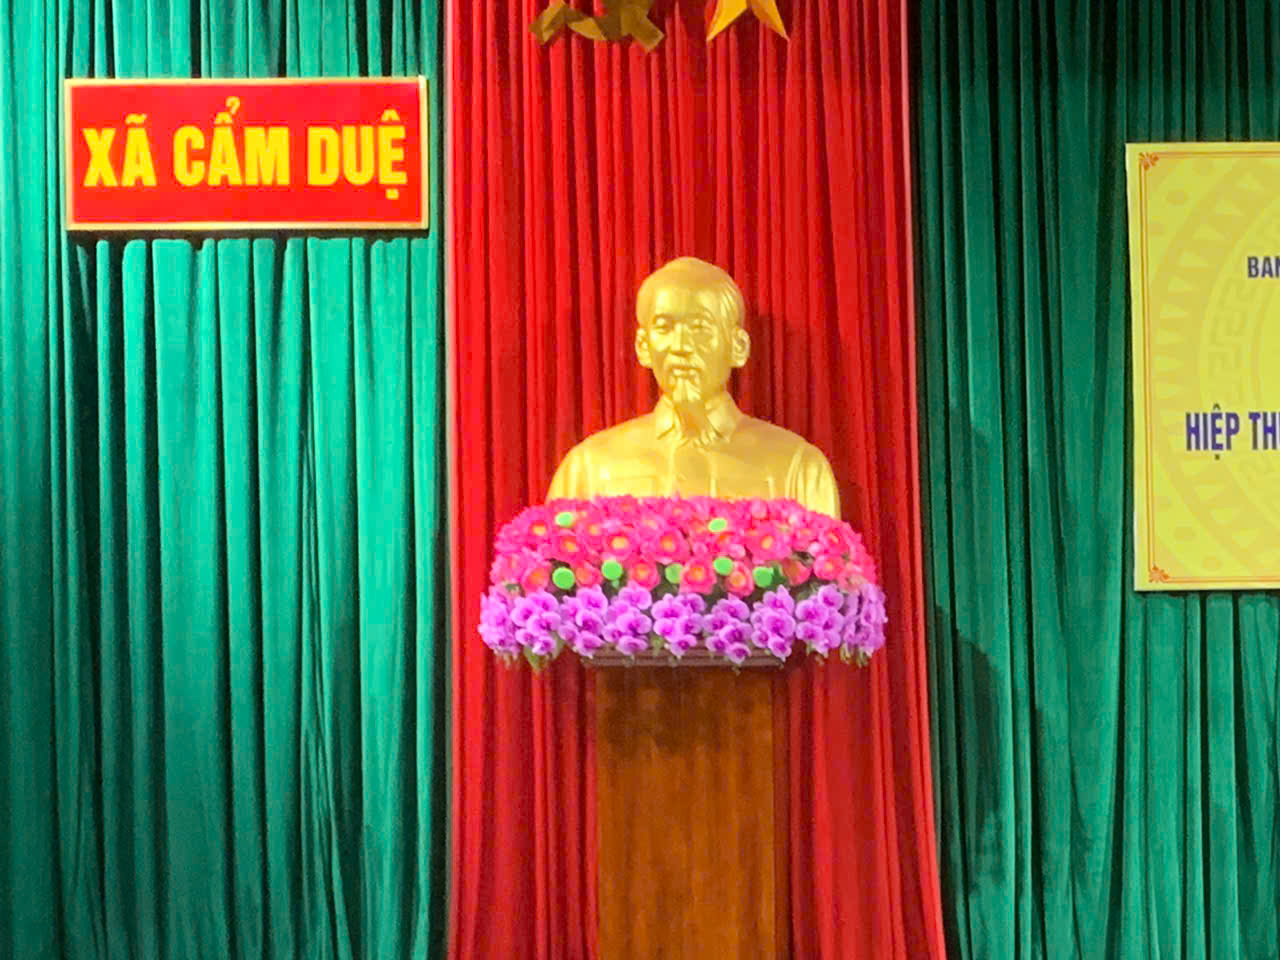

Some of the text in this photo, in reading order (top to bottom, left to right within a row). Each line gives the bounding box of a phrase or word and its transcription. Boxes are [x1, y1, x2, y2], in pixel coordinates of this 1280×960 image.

[83, 96, 407, 200] XÃ CẨM DUỆ
[1185, 403, 1240, 461] HIỆP
